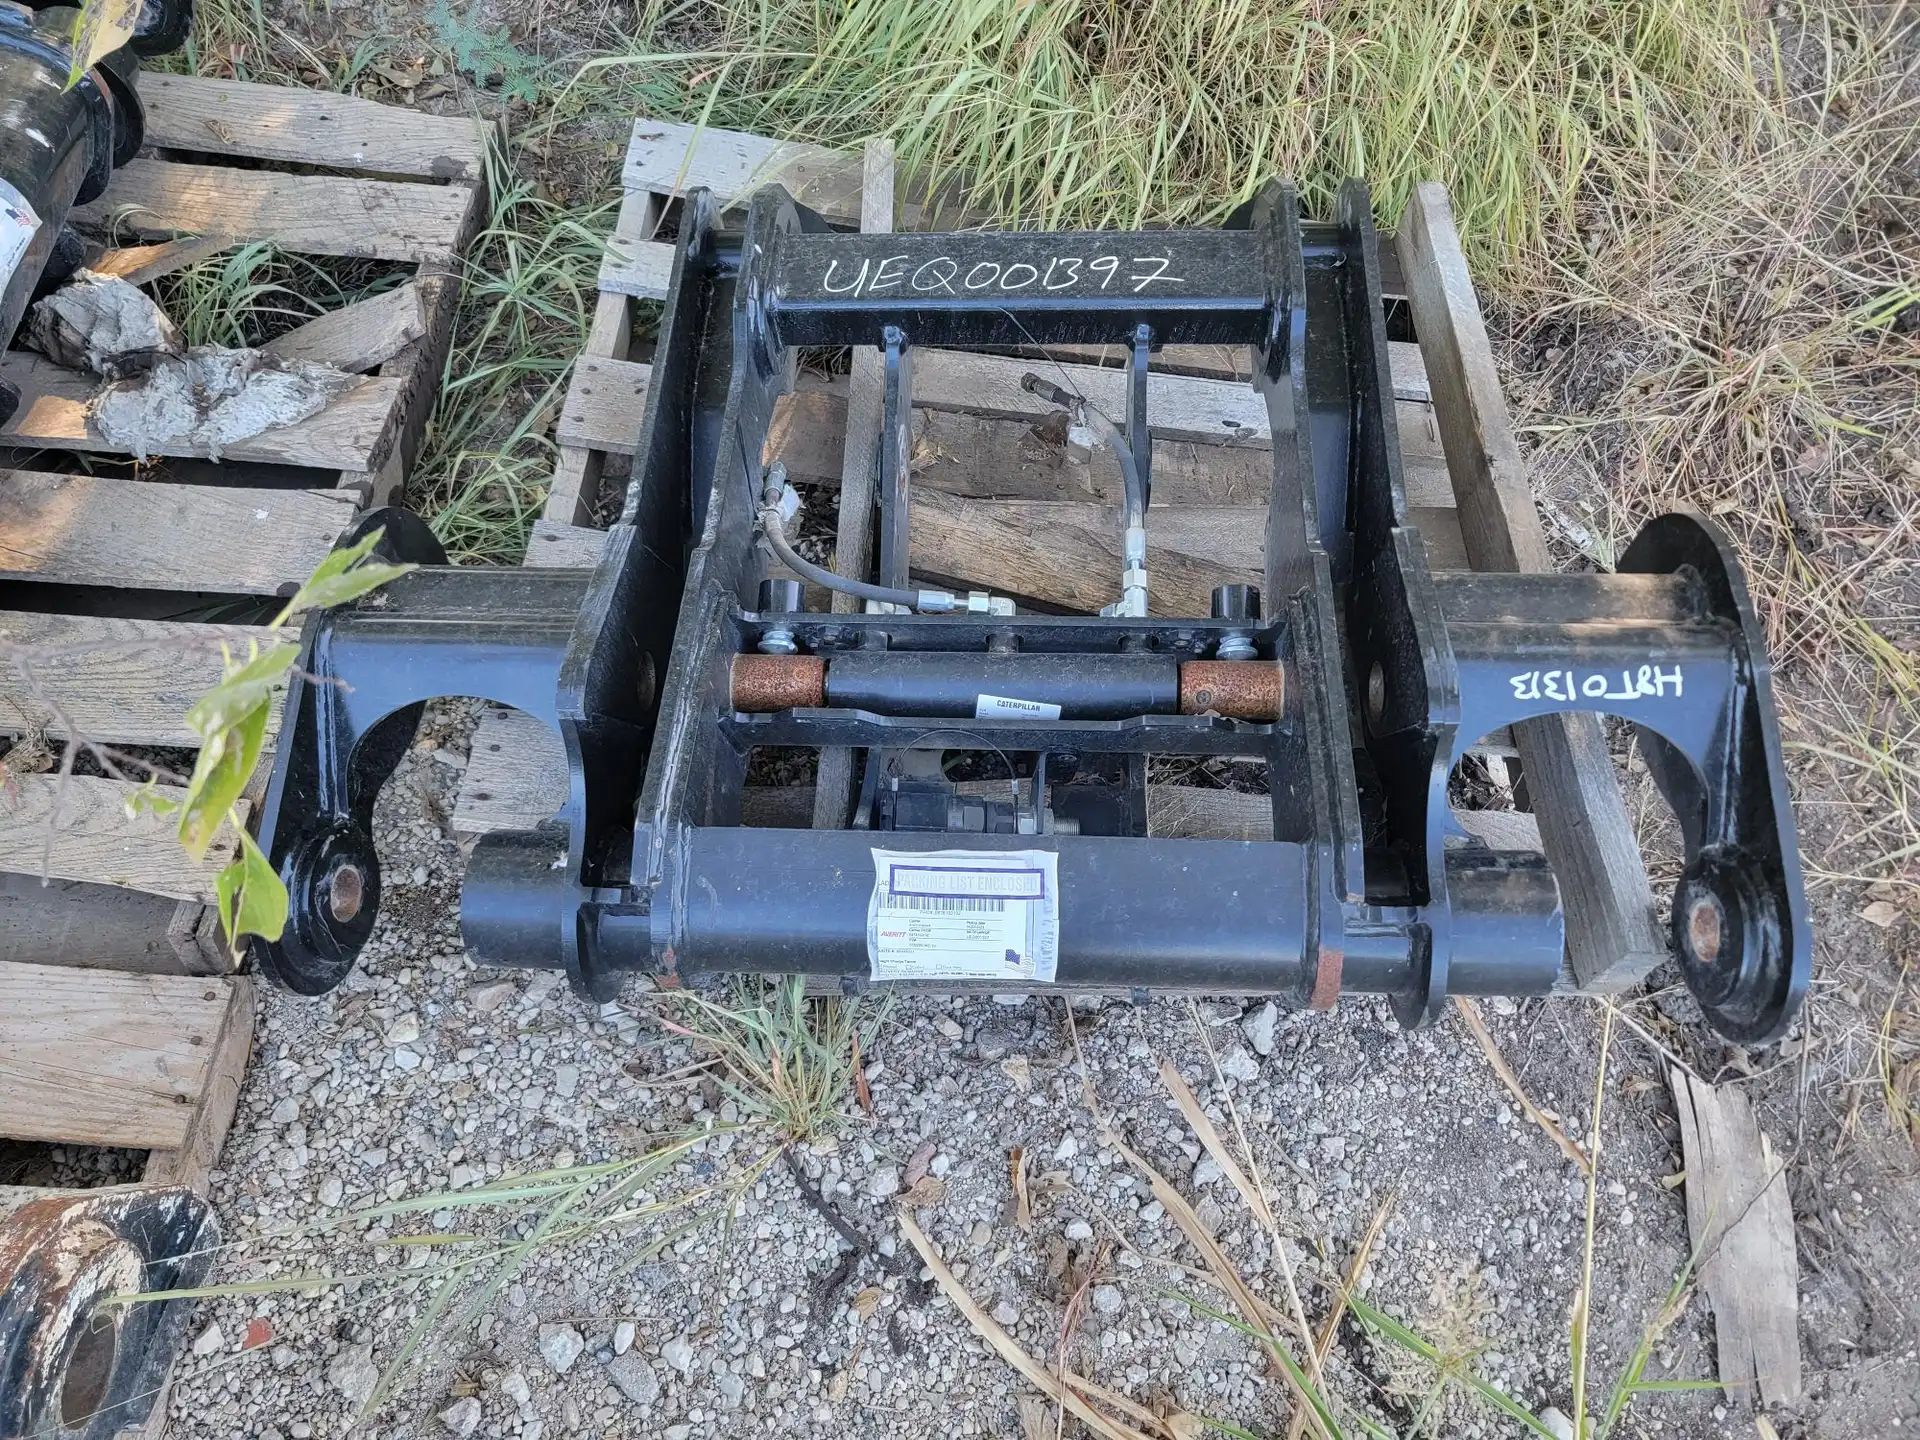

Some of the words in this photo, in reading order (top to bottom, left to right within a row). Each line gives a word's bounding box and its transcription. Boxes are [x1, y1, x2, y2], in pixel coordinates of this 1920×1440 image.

[823, 255, 1185, 298] UEQ001397
[996, 699, 1041, 712] CATERPILLAR
[896, 873, 946, 890] PACKING
[949, 875, 976, 890] LIST
[977, 875, 1038, 892] ENCLOSED
